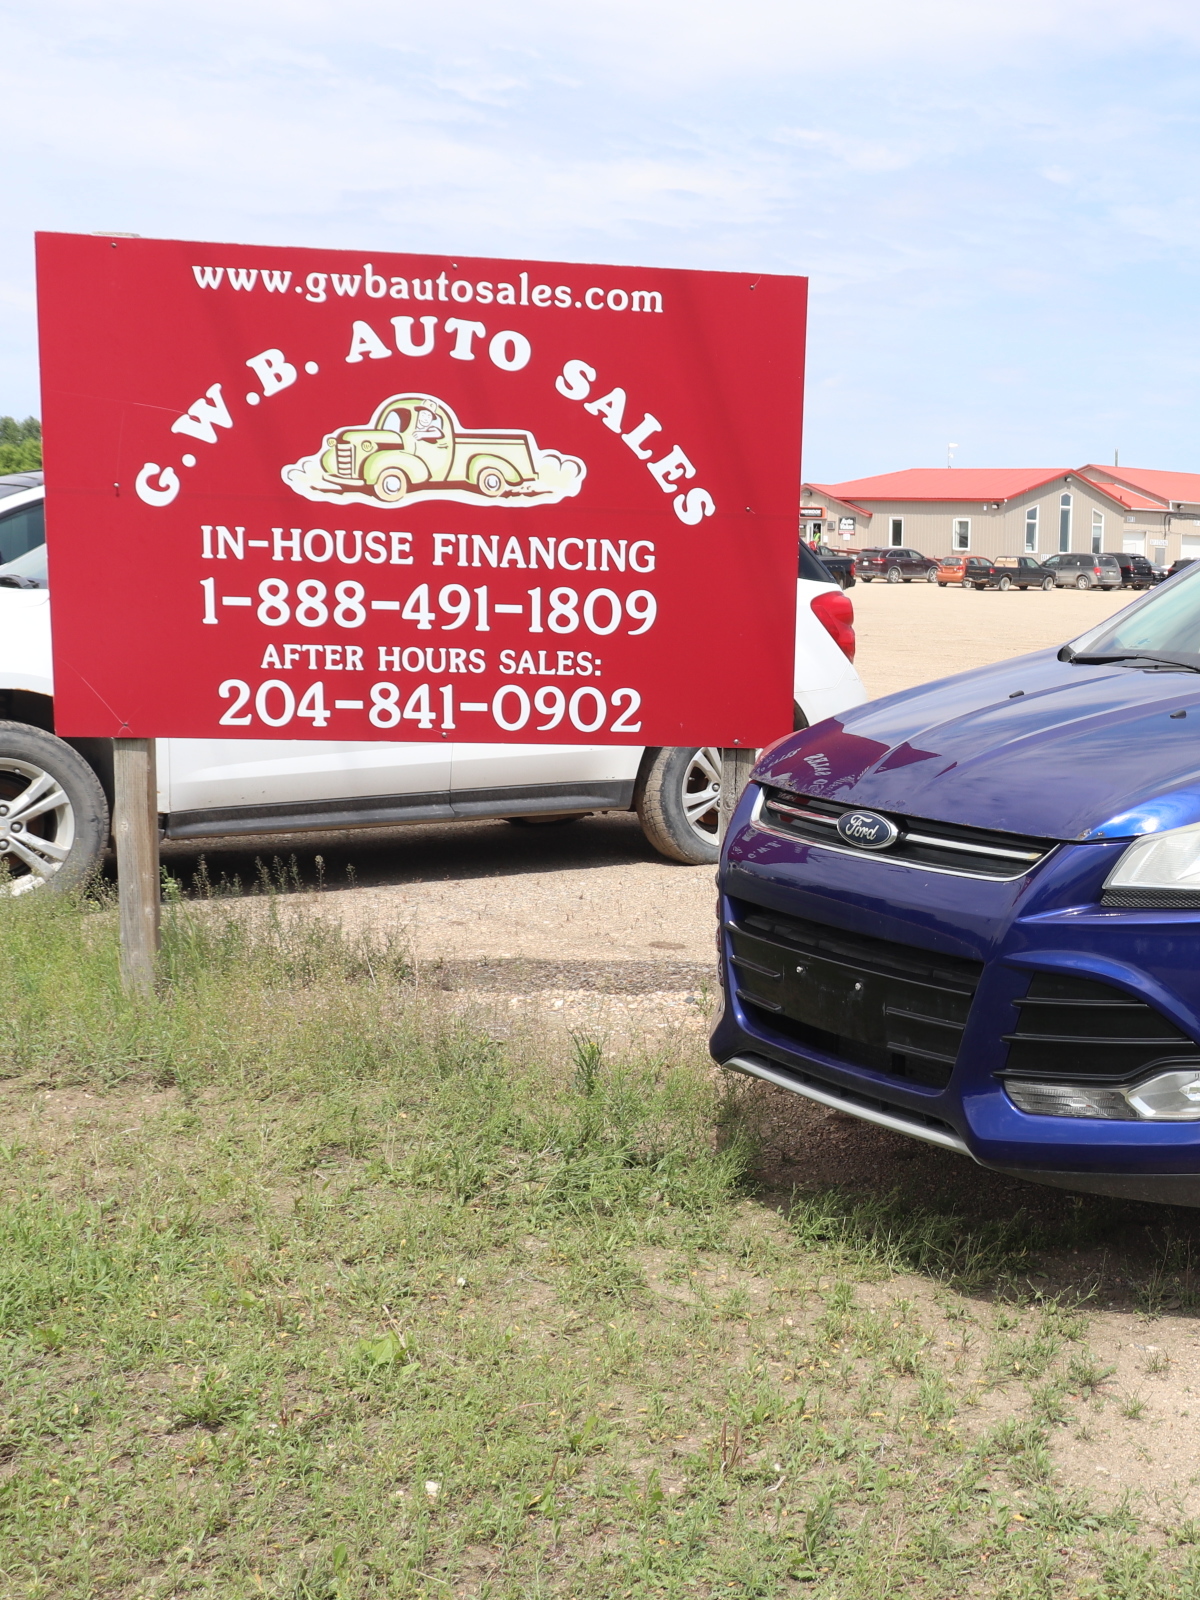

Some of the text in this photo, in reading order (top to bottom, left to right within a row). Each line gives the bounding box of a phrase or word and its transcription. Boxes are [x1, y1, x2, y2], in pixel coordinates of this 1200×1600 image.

[191, 262, 664, 314] www.gwbautosales.com
[134, 315, 716, 526] G.W.B. AUTO SALES
[200, 524, 656, 574] IN-HOUSE FINANCING
[199, 576, 658, 636] 1-888-491-1809
[260, 643, 602, 677] AFTER HOURS SALES:
[218, 678, 642, 733] 204-841-0902
[845, 814, 880, 840] Ford
